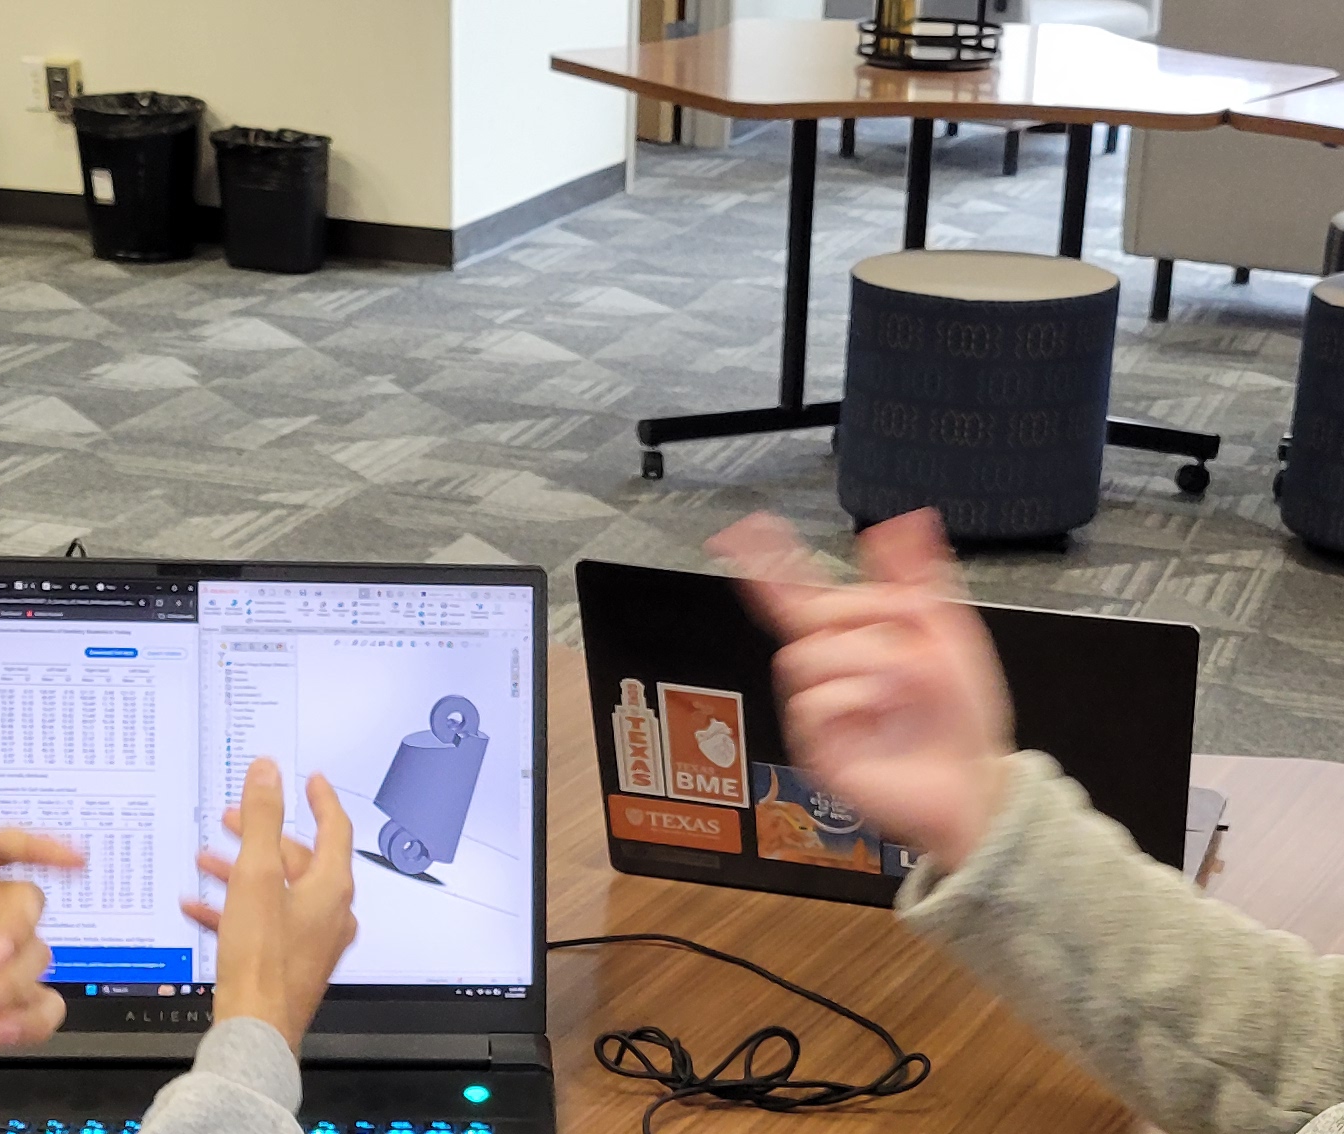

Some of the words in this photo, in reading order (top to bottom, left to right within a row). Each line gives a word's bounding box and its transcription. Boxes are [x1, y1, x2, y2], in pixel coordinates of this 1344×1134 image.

[625, 716, 652, 787] TEXAS
[676, 771, 740, 798] BME
[646, 810, 721, 835] TEXAS
[125, 1010, 214, 1023] ALIEN
